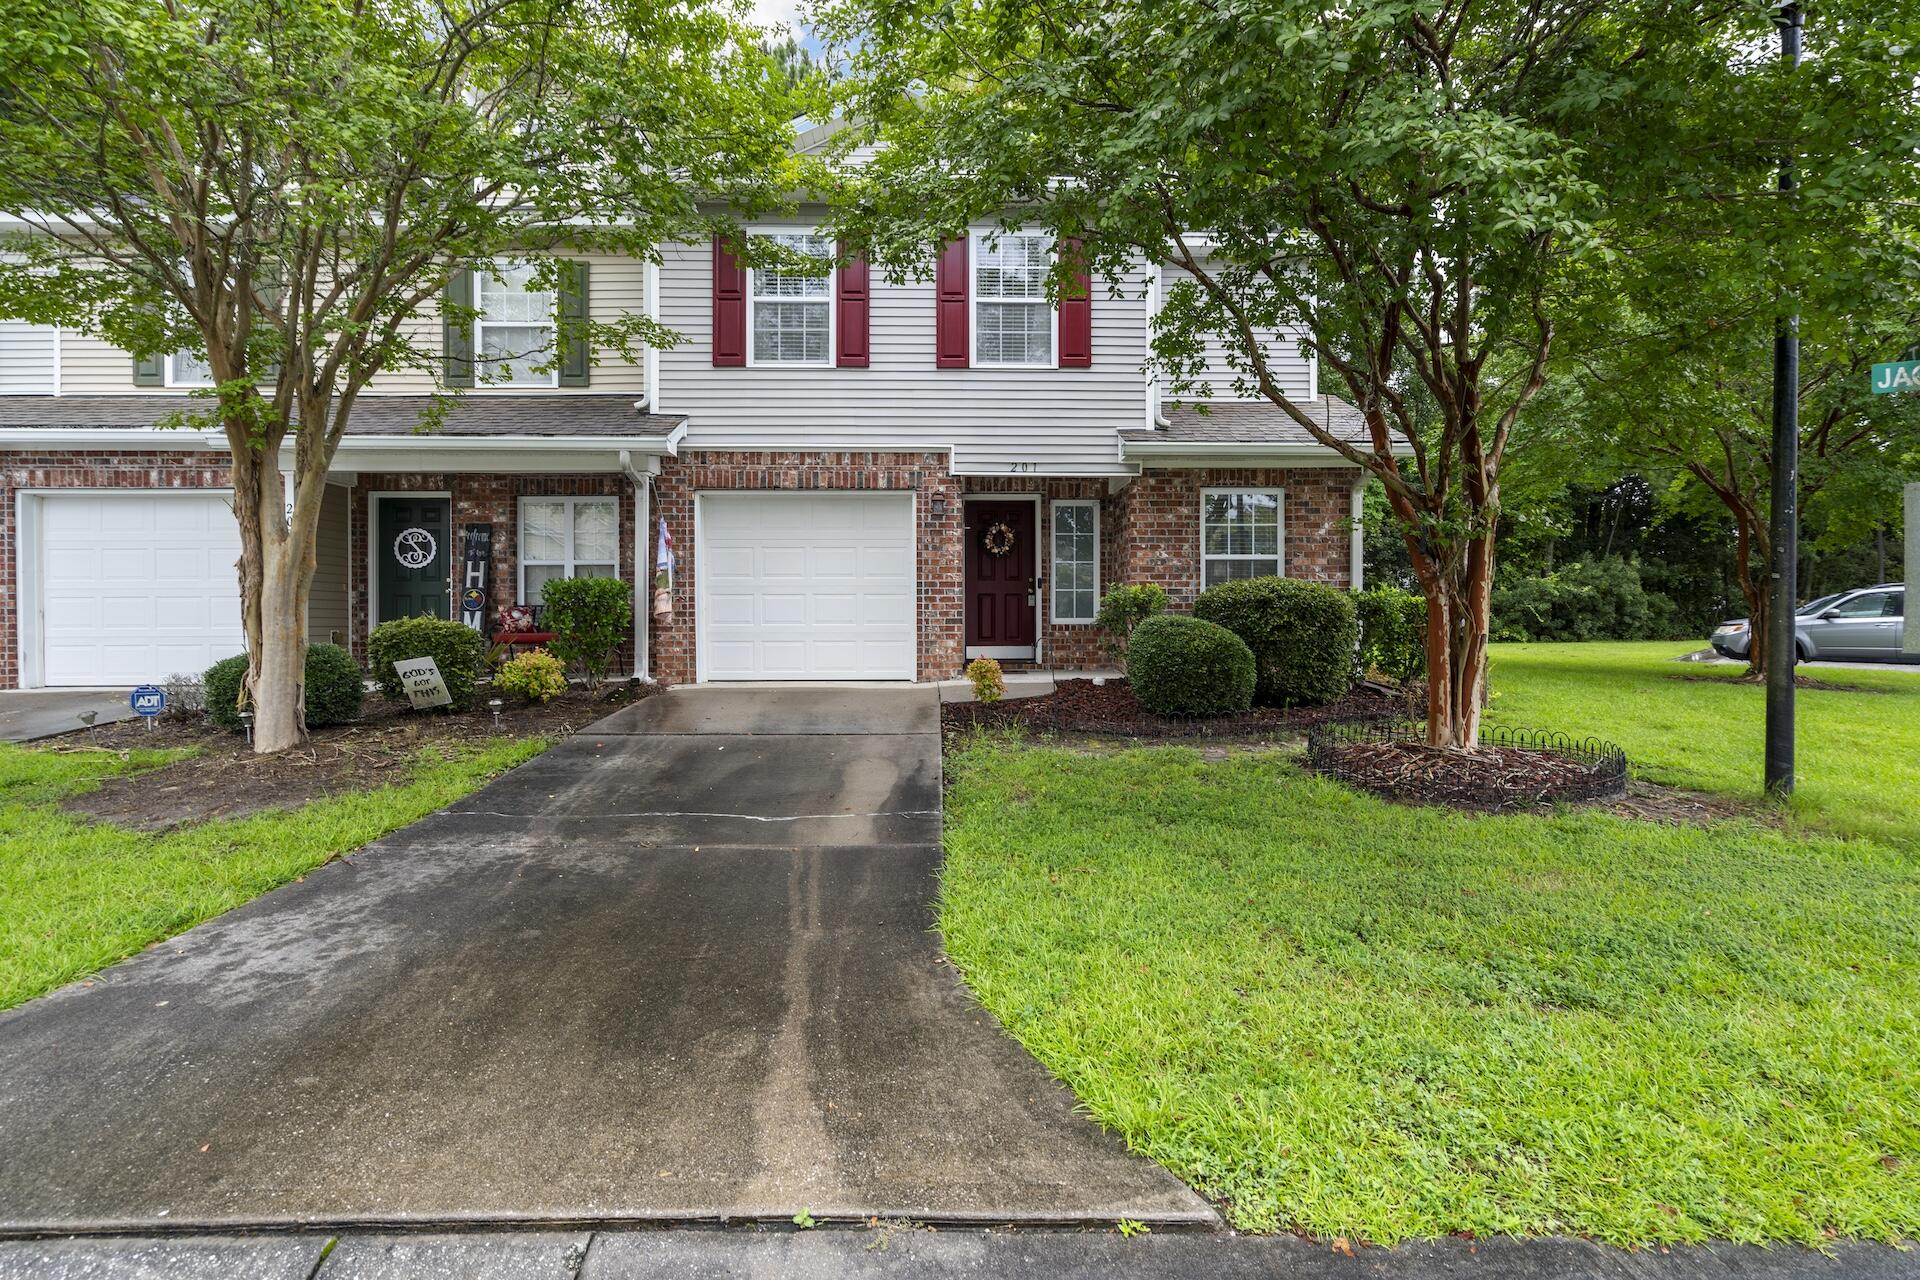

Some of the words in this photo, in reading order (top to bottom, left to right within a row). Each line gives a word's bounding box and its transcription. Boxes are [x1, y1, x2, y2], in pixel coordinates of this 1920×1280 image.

[1010, 462, 1037, 473] 201
[402, 668, 435, 679] GOD'S
[414, 678, 431, 687] GOT
[413, 686, 440, 698] THIS
[136, 695, 160, 707] ADT
